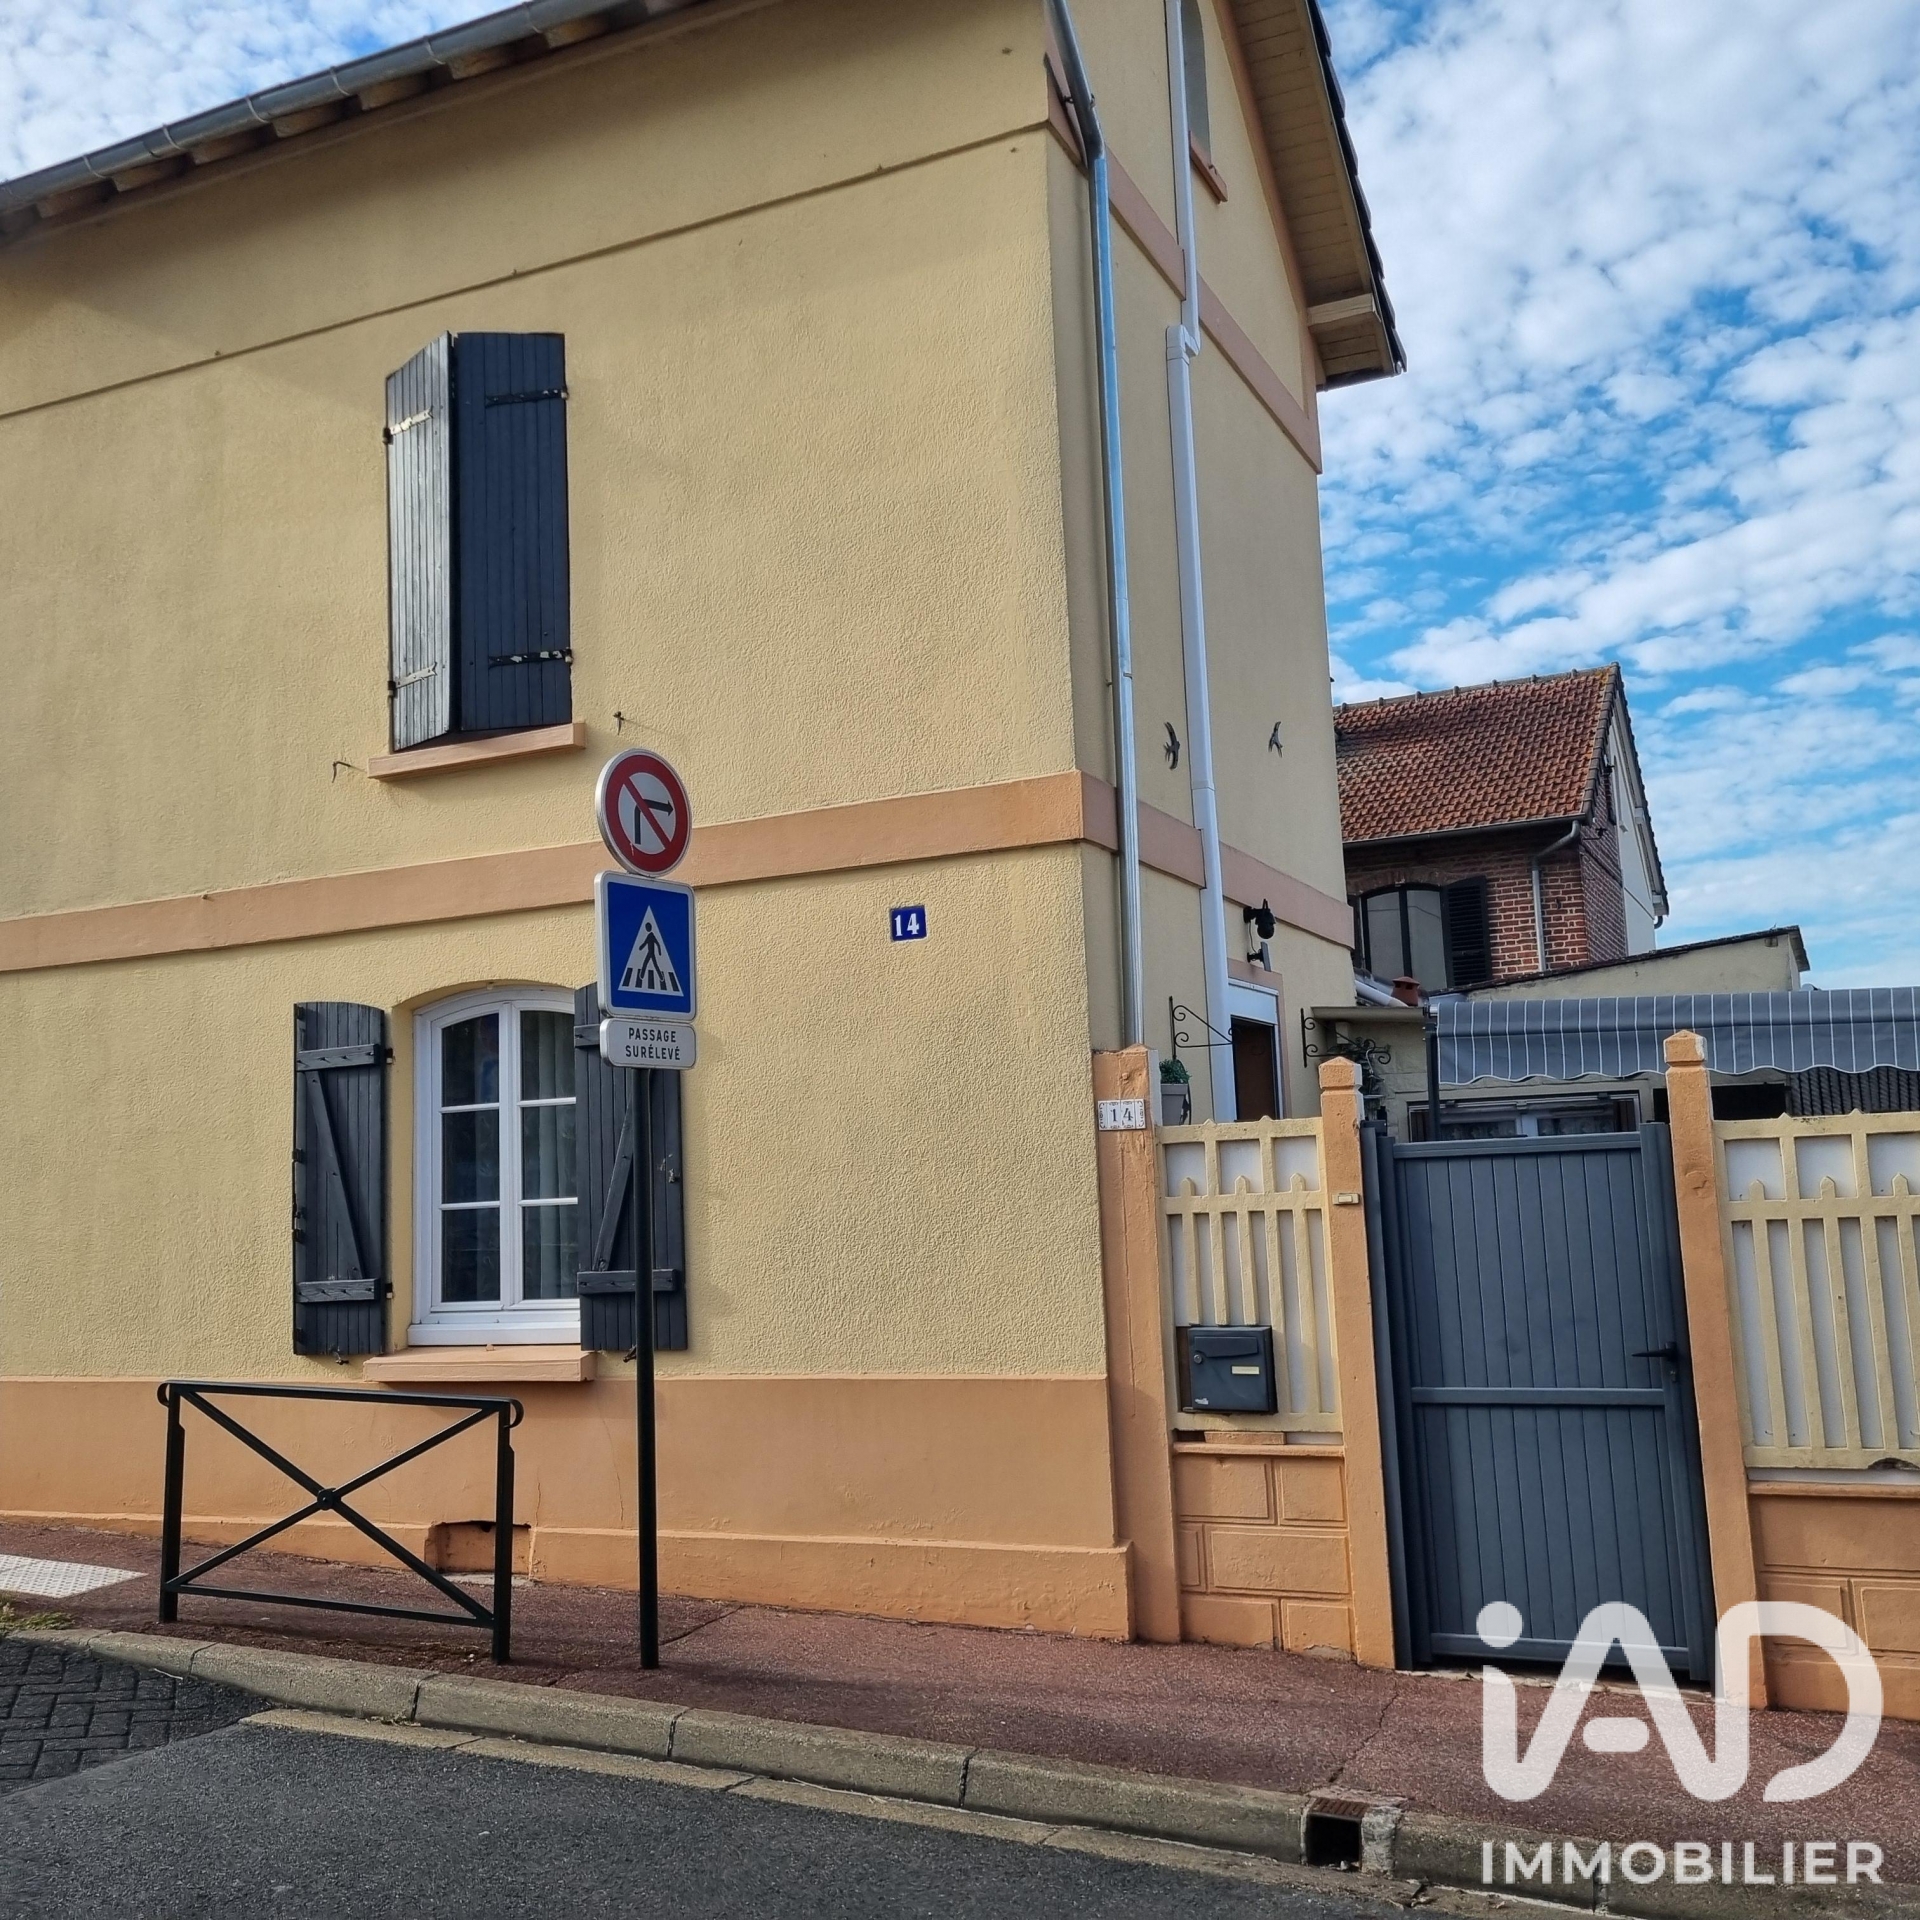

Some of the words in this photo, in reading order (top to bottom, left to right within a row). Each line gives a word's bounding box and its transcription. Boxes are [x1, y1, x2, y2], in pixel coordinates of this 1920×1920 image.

[894, 913, 920, 937] 14
[628, 1027, 677, 1043] PASSAGE
[625, 1044, 681, 1061] SURÉLEVÉ
[1110, 1107, 1134, 1122] 14
